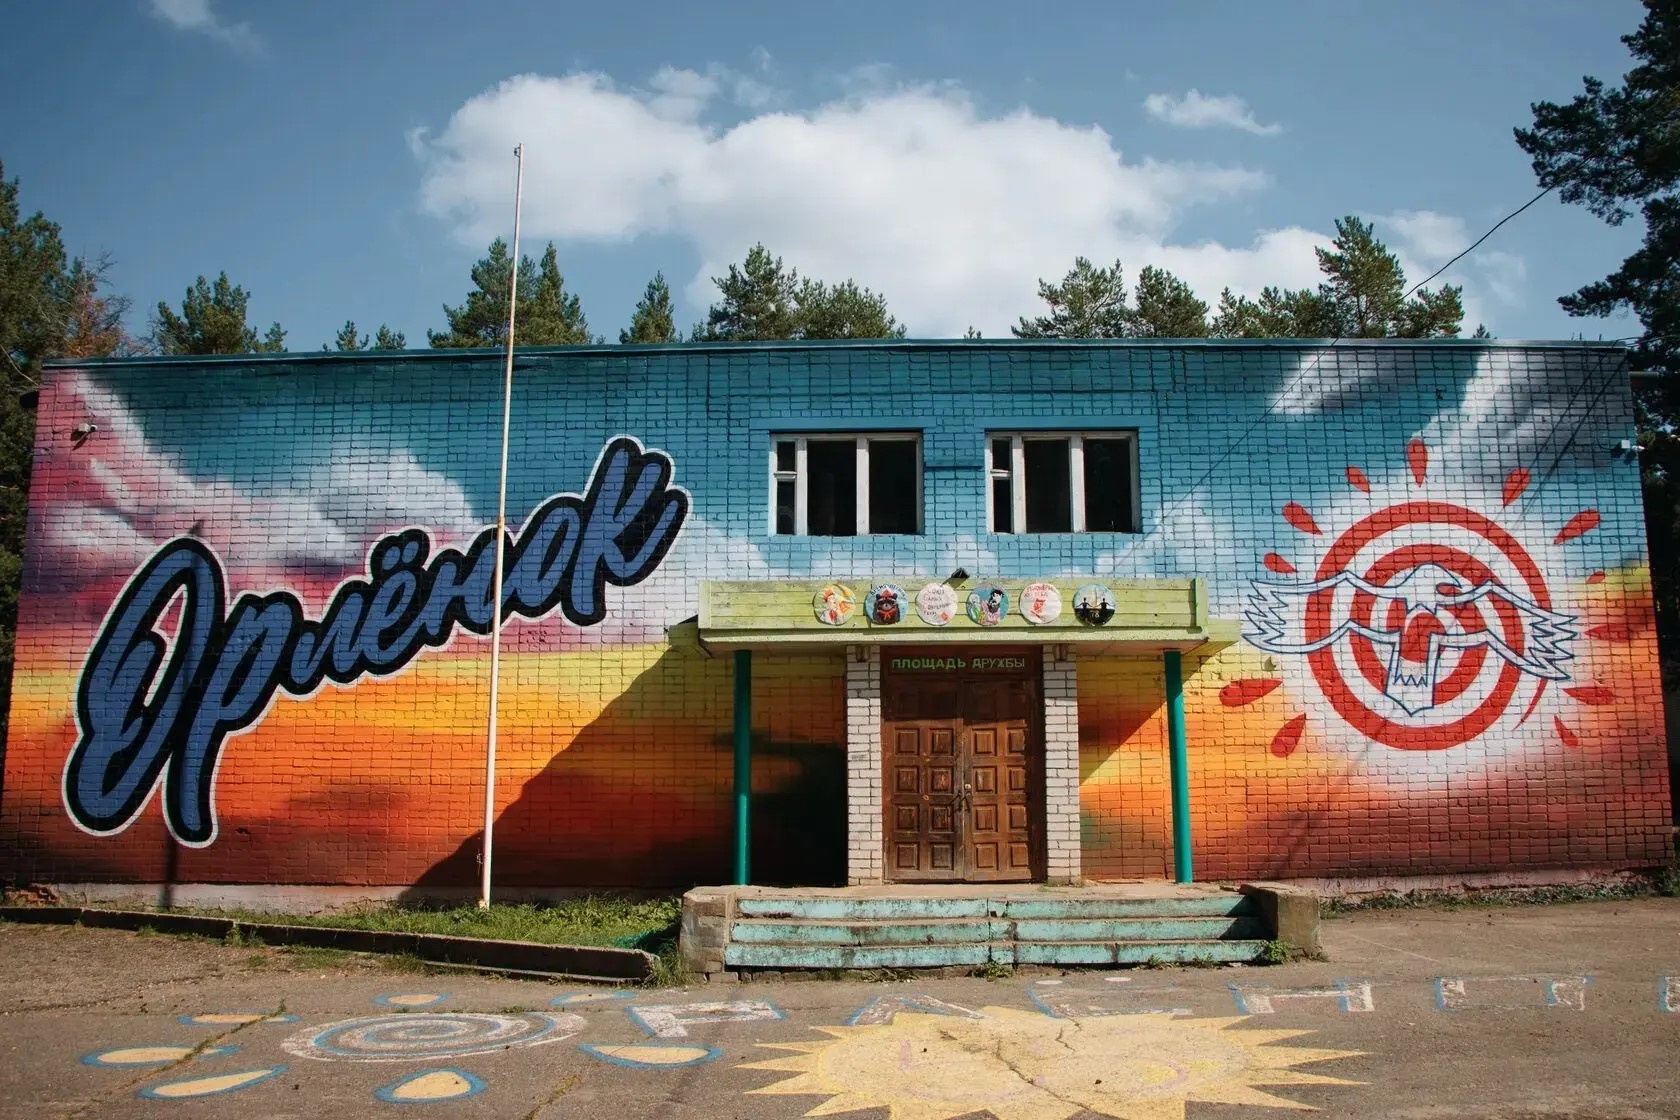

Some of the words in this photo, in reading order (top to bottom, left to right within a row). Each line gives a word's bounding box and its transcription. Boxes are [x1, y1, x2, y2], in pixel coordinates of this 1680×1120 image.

[65, 435, 692, 847] Орлёнок
[891, 657, 967, 670] ПЛОЩАДЬ
[971, 657, 1025, 670] ДРУЖБЫ
